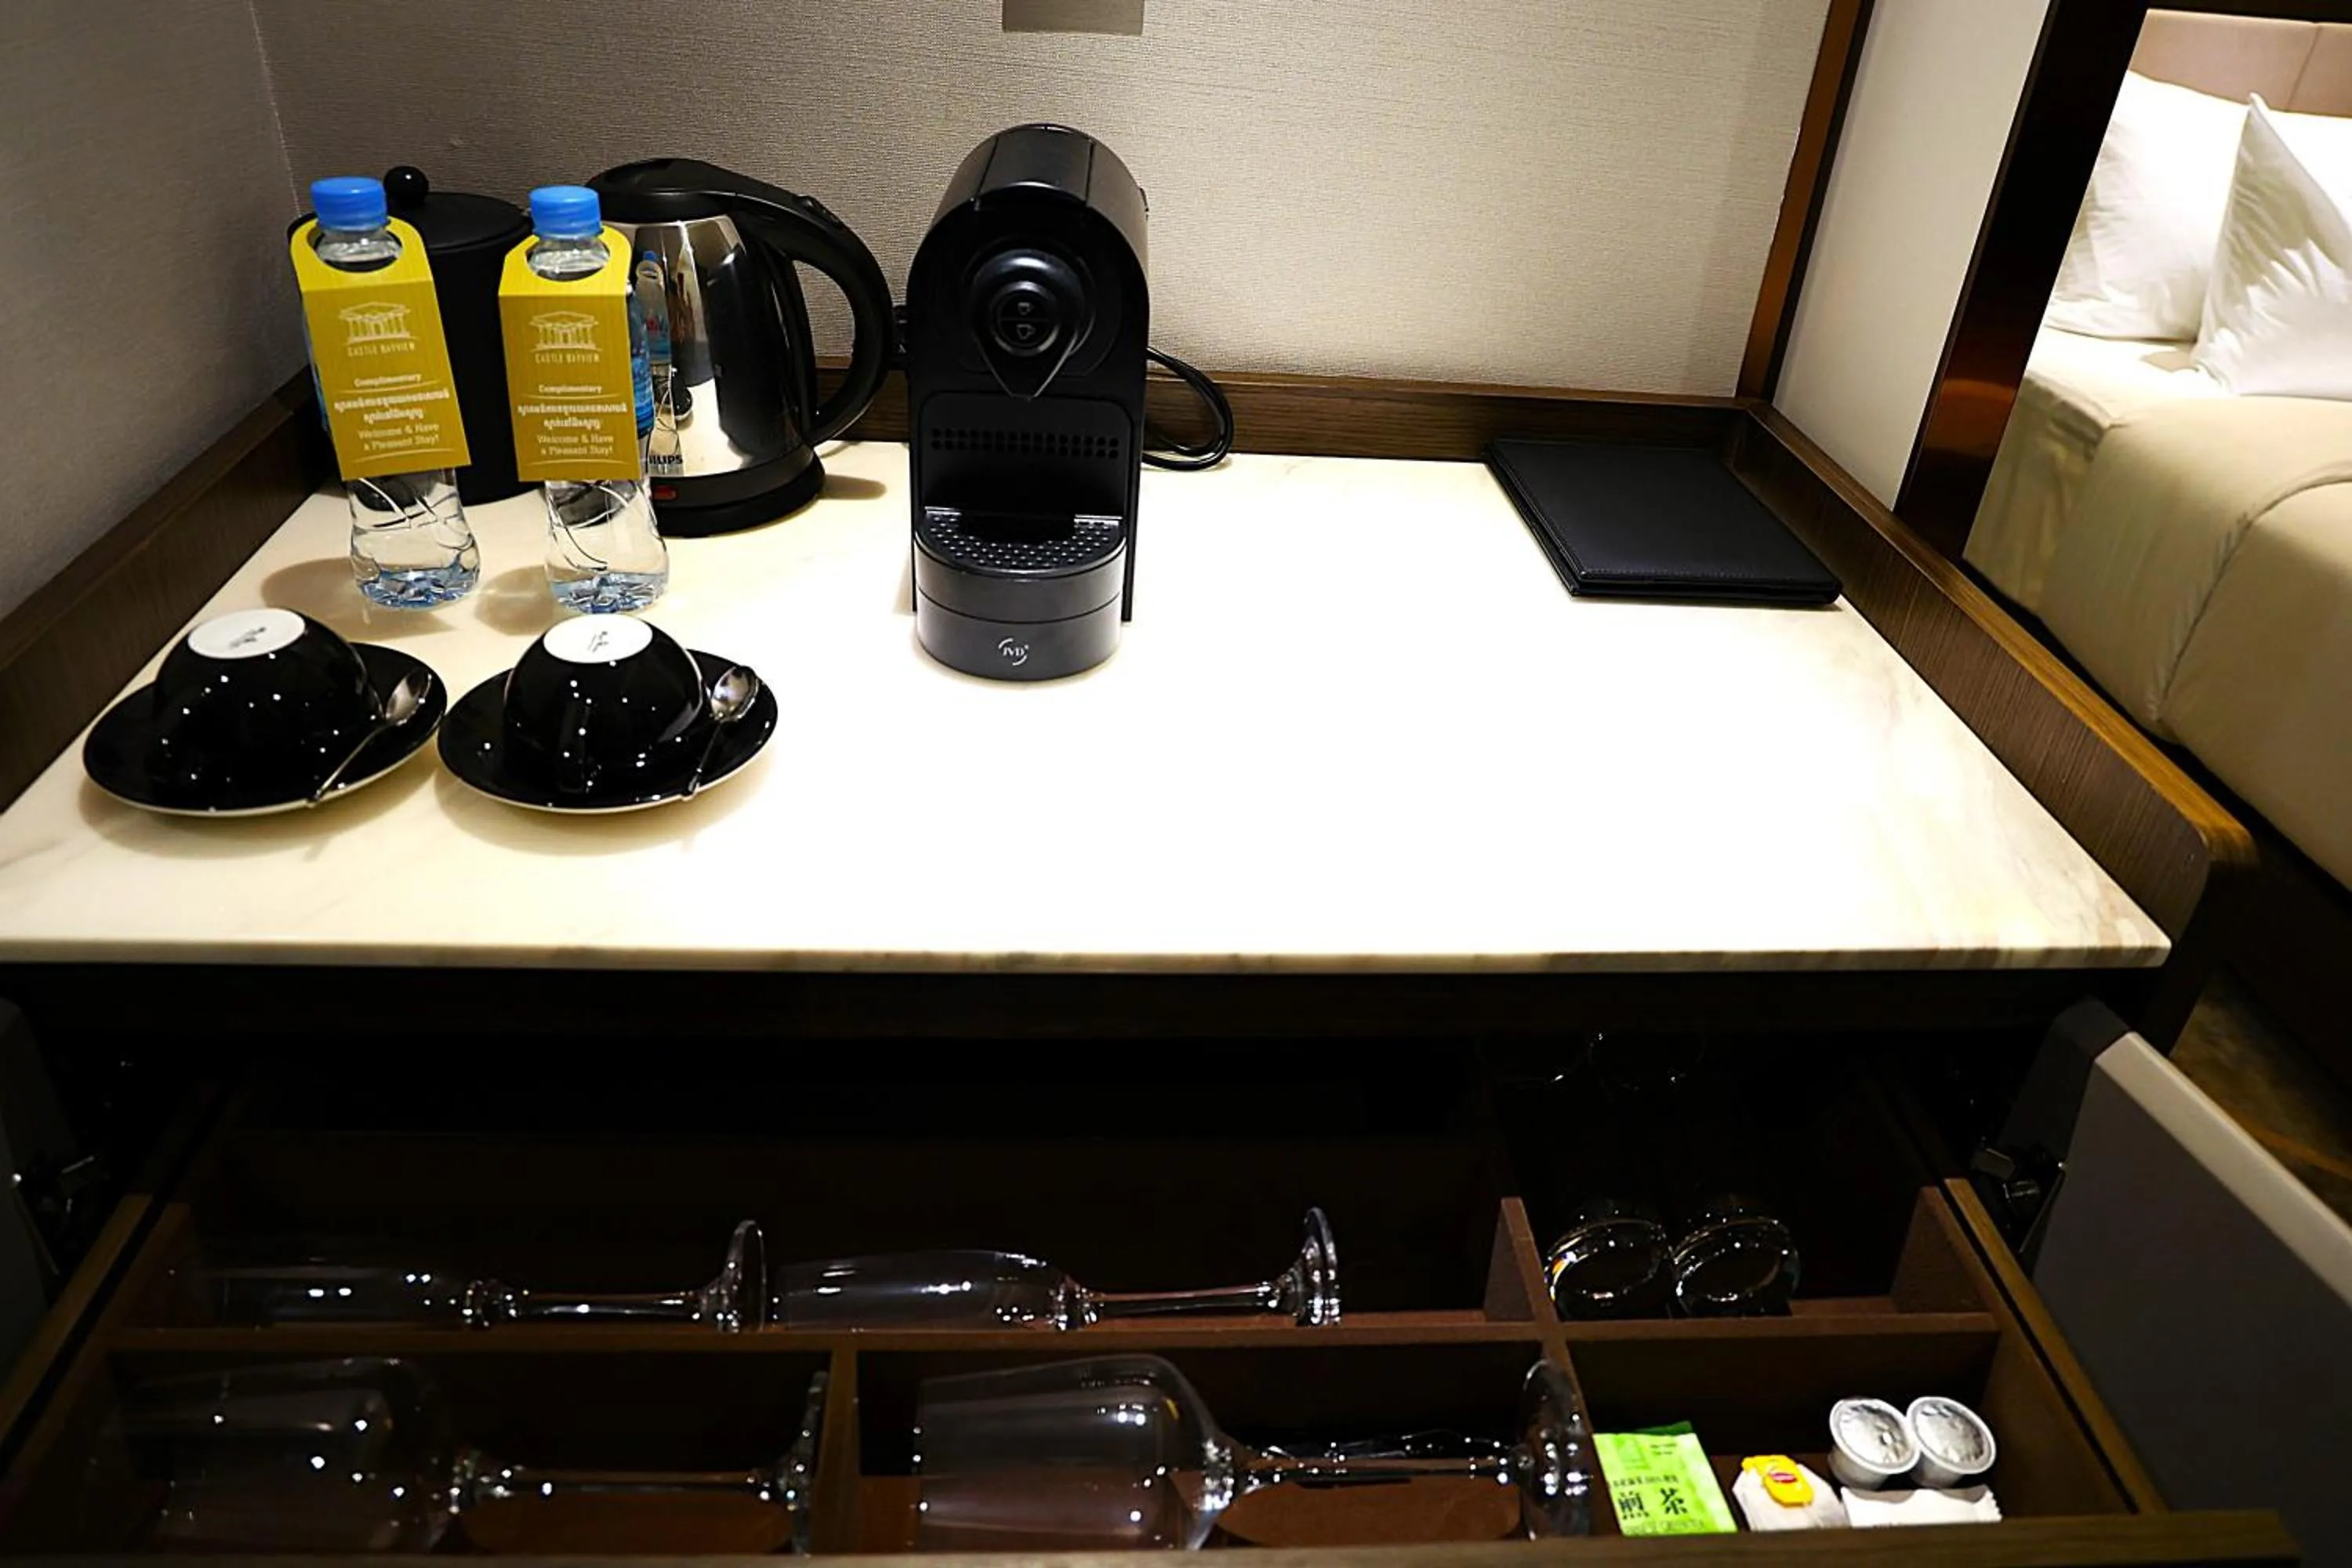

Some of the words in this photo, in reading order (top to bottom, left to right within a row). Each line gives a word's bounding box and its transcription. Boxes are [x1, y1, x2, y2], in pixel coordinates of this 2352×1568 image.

[347, 345, 378, 357] CASTLE
[535, 352, 563, 364] CASTLE
[354, 374, 422, 387] Complimentary
[539, 384, 603, 395] Complimentary
[358, 427, 402, 440] Welcome
[405, 425, 413, 434] &
[416, 423, 440, 433] Have
[364, 443, 370, 452] a
[372, 437, 414, 451] Pleasant
[416, 434, 440, 446] Stay!
[537, 434, 579, 444] Welcome
[581, 434, 589, 444] &
[590, 434, 614, 444] Have
[549, 446, 587, 456] Pleasant
[590, 445, 613, 457] Stay!
